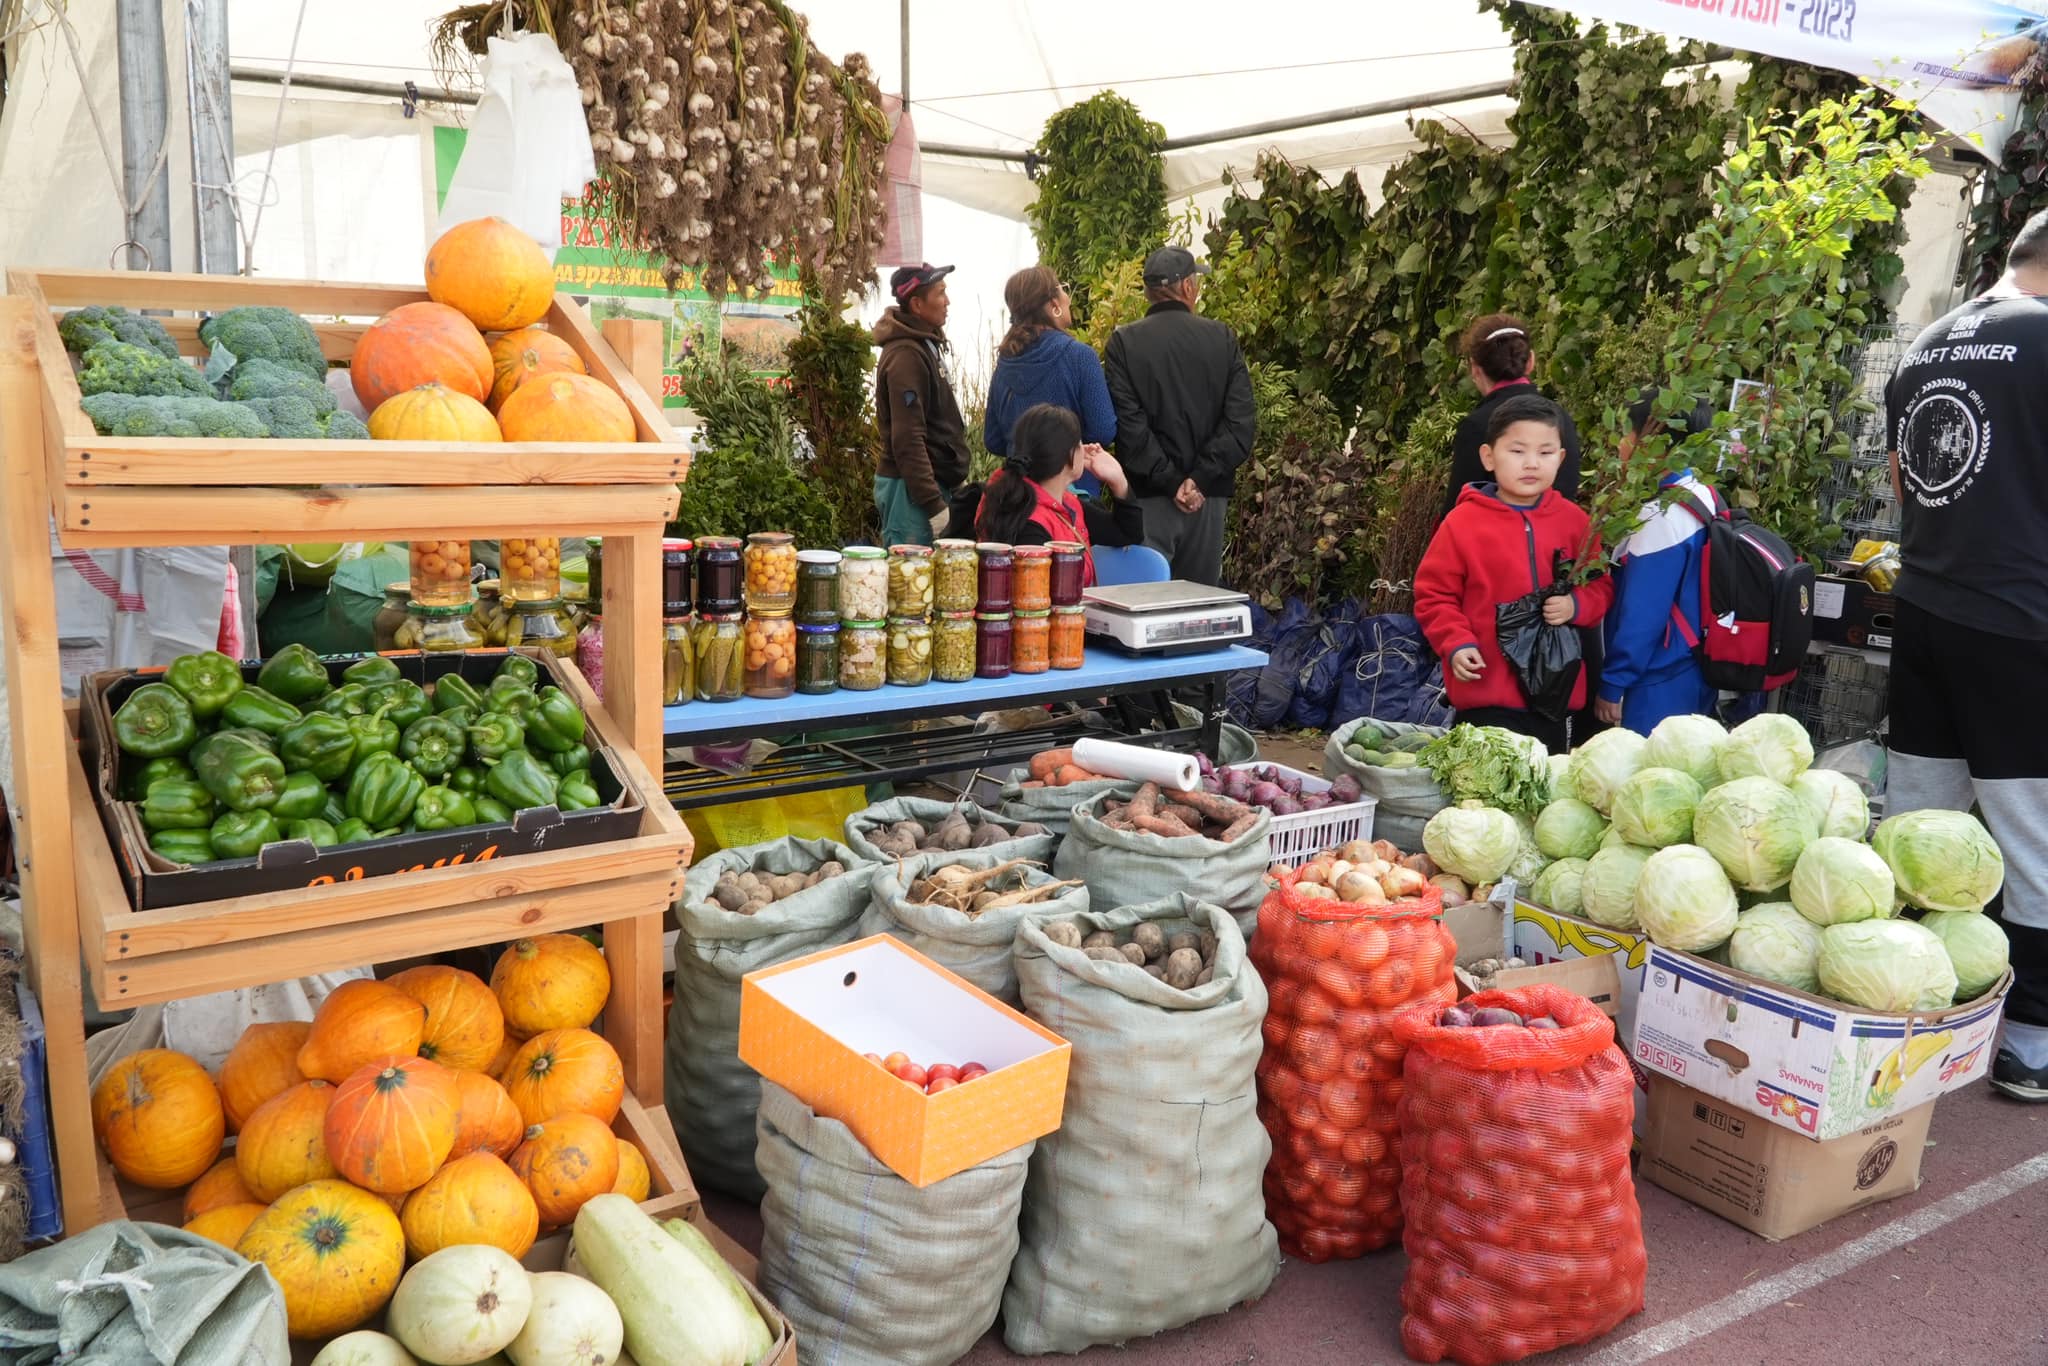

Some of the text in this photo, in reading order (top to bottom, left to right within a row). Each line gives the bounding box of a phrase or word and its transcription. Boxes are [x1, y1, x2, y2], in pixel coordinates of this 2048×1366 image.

[1904, 344, 2017, 368] SHAFT SINKER
[1967, 389, 1987, 415] DRILL
[1777, 1068, 1824, 1093] BANANAS
[1755, 1085, 1819, 1134] Dole
